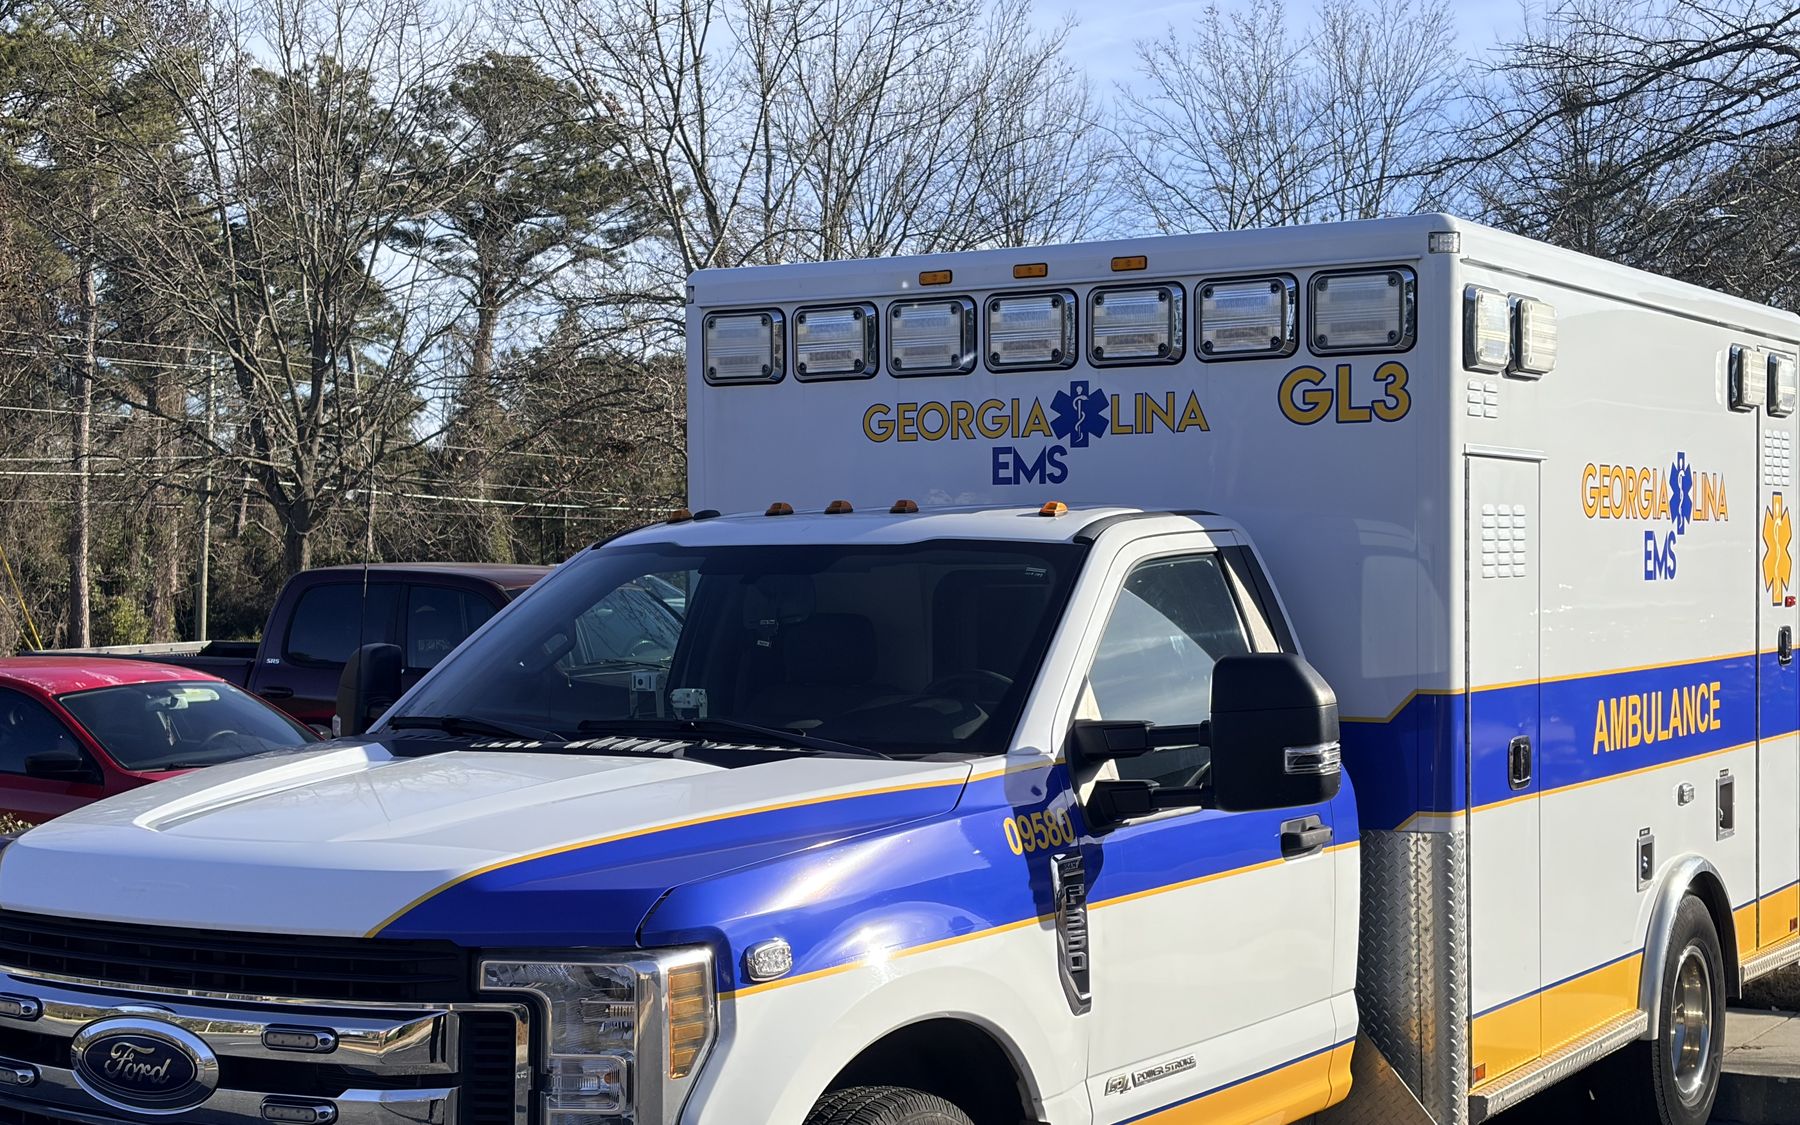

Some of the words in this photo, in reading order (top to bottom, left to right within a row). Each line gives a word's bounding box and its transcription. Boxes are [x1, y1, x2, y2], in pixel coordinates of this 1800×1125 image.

[863, 396, 1053, 443] GEORGIA
[1110, 389, 1212, 435] LINA
[1277, 361, 1412, 426] GL3
[991, 445, 1069, 486] EMS
[1581, 462, 1671, 520] GEORGIA
[1692, 471, 1729, 522] LINA
[1643, 530, 1677, 581] EMS
[1592, 681, 1722, 756] AMBULANCE
[1003, 807, 1075, 856] 09580
[104, 1041, 172, 1084] Ford
[1136, 1066, 1165, 1082] POWER
[1164, 1055, 1196, 1073] STROKE
